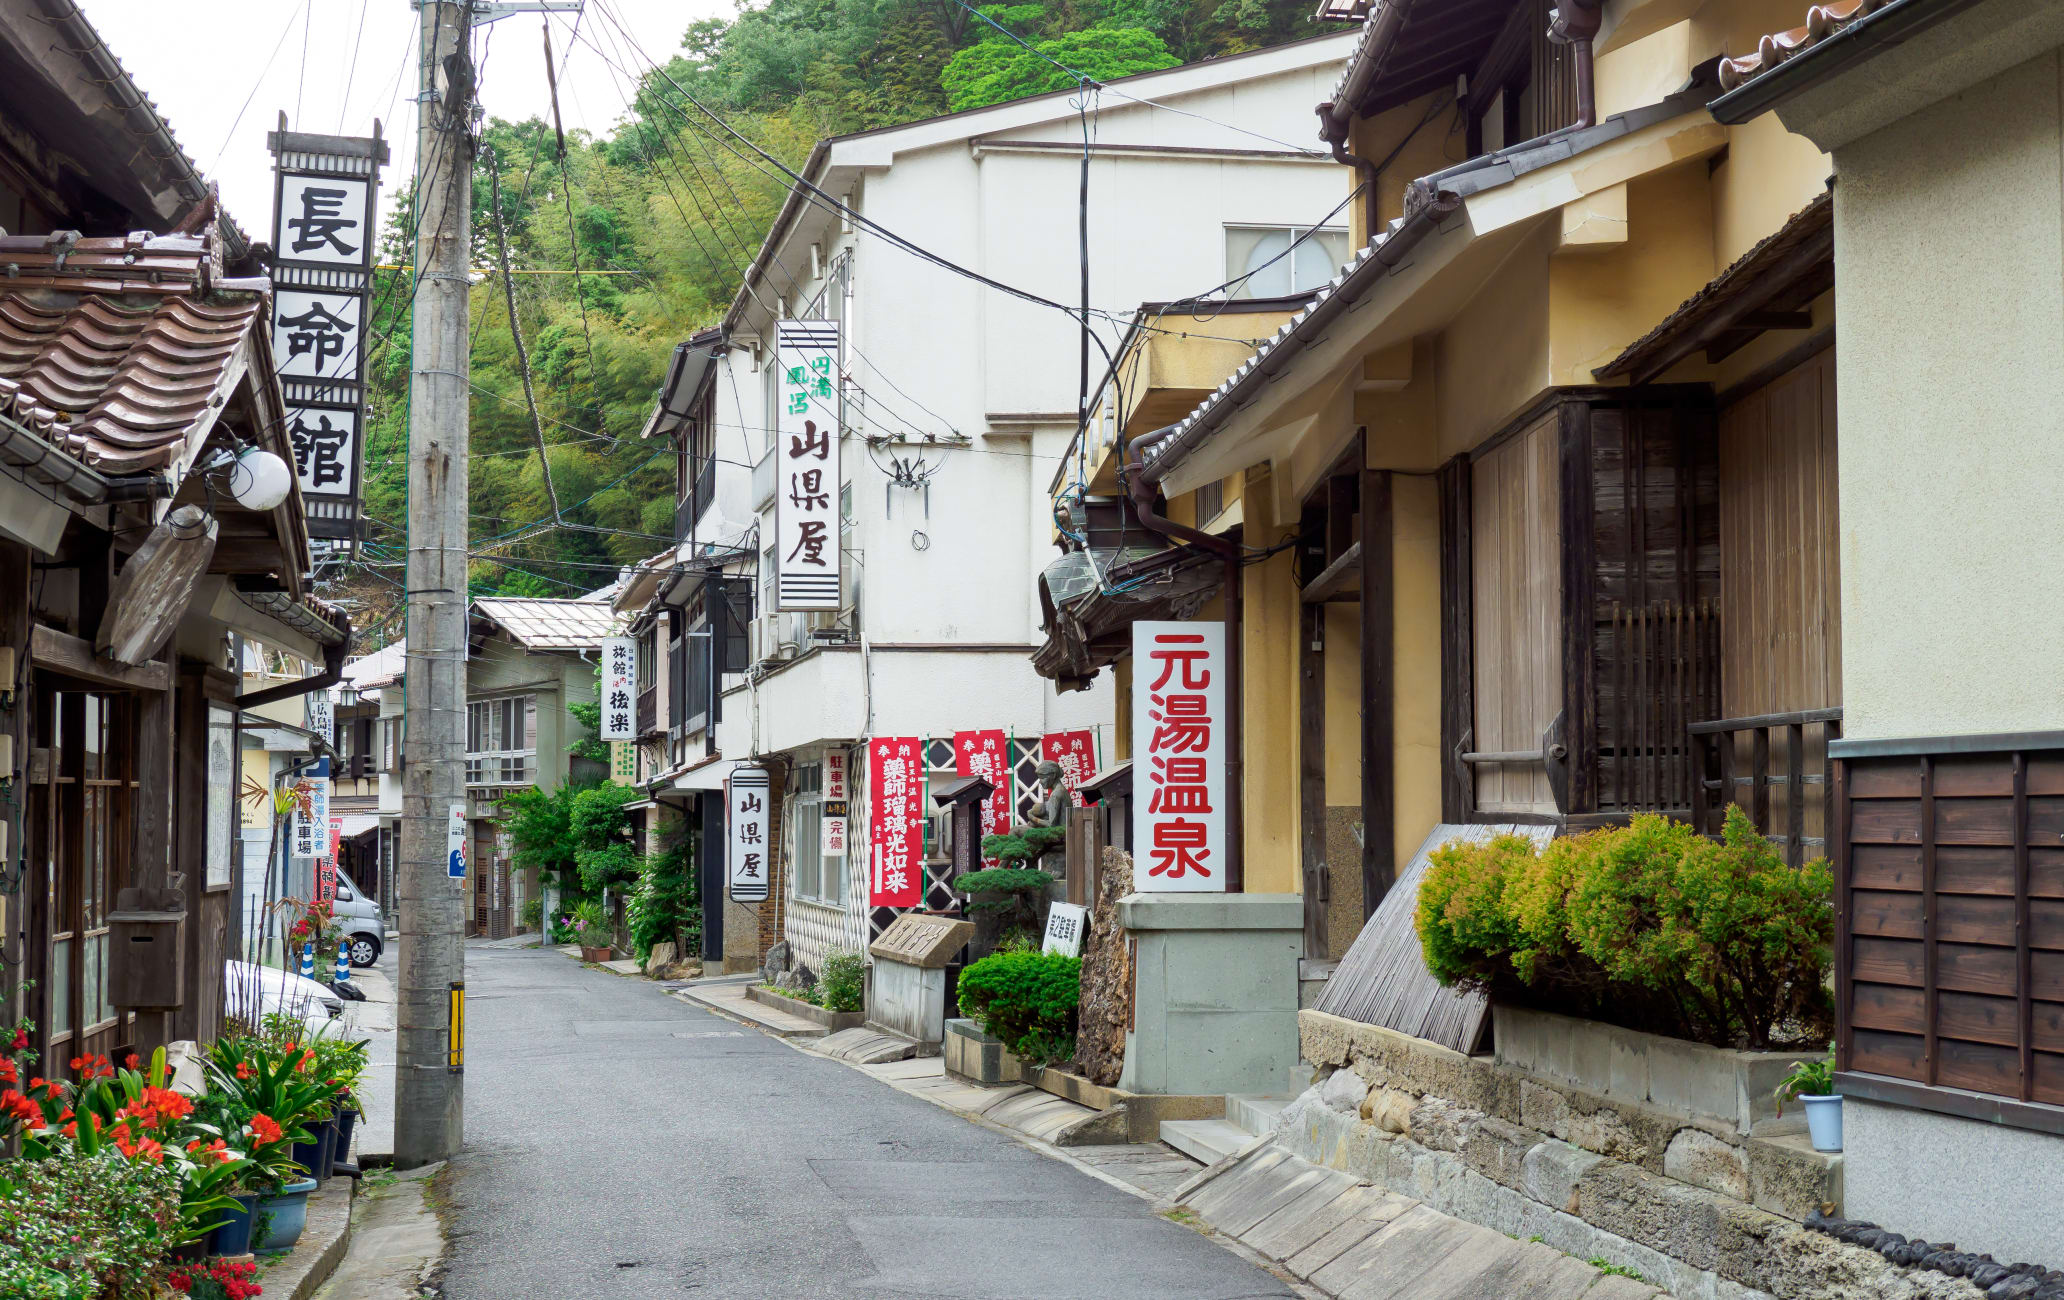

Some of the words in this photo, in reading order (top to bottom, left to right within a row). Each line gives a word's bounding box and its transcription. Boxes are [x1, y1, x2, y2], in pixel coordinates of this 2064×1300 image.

[278, 187, 359, 488] 長命館
[786, 366, 809, 415] 風呂
[810, 356, 831, 400] 円満
[787, 420, 830, 567] 山県屋
[612, 645, 626, 675] 旅館
[878, 744, 911, 757] 奉納
[1148, 634, 1213, 878] 元湯温泉
[829, 756, 843, 798] 駐車場
[737, 792, 762, 878] 山県屋
